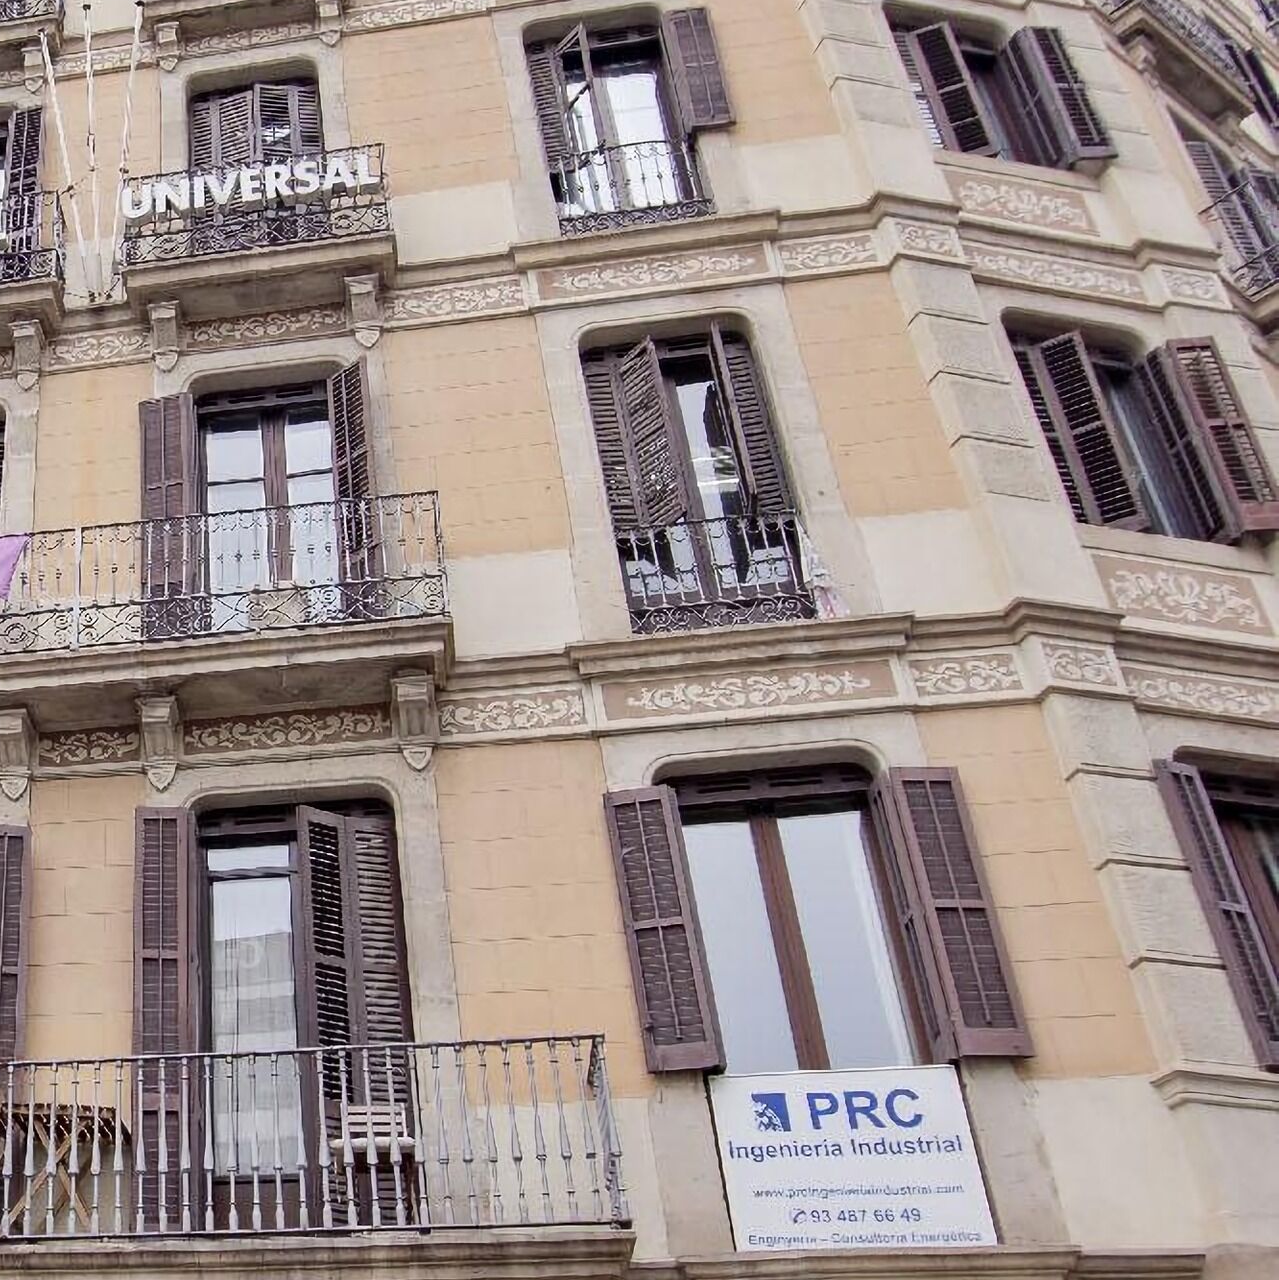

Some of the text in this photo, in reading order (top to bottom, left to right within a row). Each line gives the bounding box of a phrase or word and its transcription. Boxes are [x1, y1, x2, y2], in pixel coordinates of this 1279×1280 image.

[120, 154, 381, 220] UNIVERSAL
[806, 1088, 924, 1132] PRC
[728, 1135, 963, 1163] Ingeniería Industrial
[810, 1207, 921, 1223] 93 487 66 49
